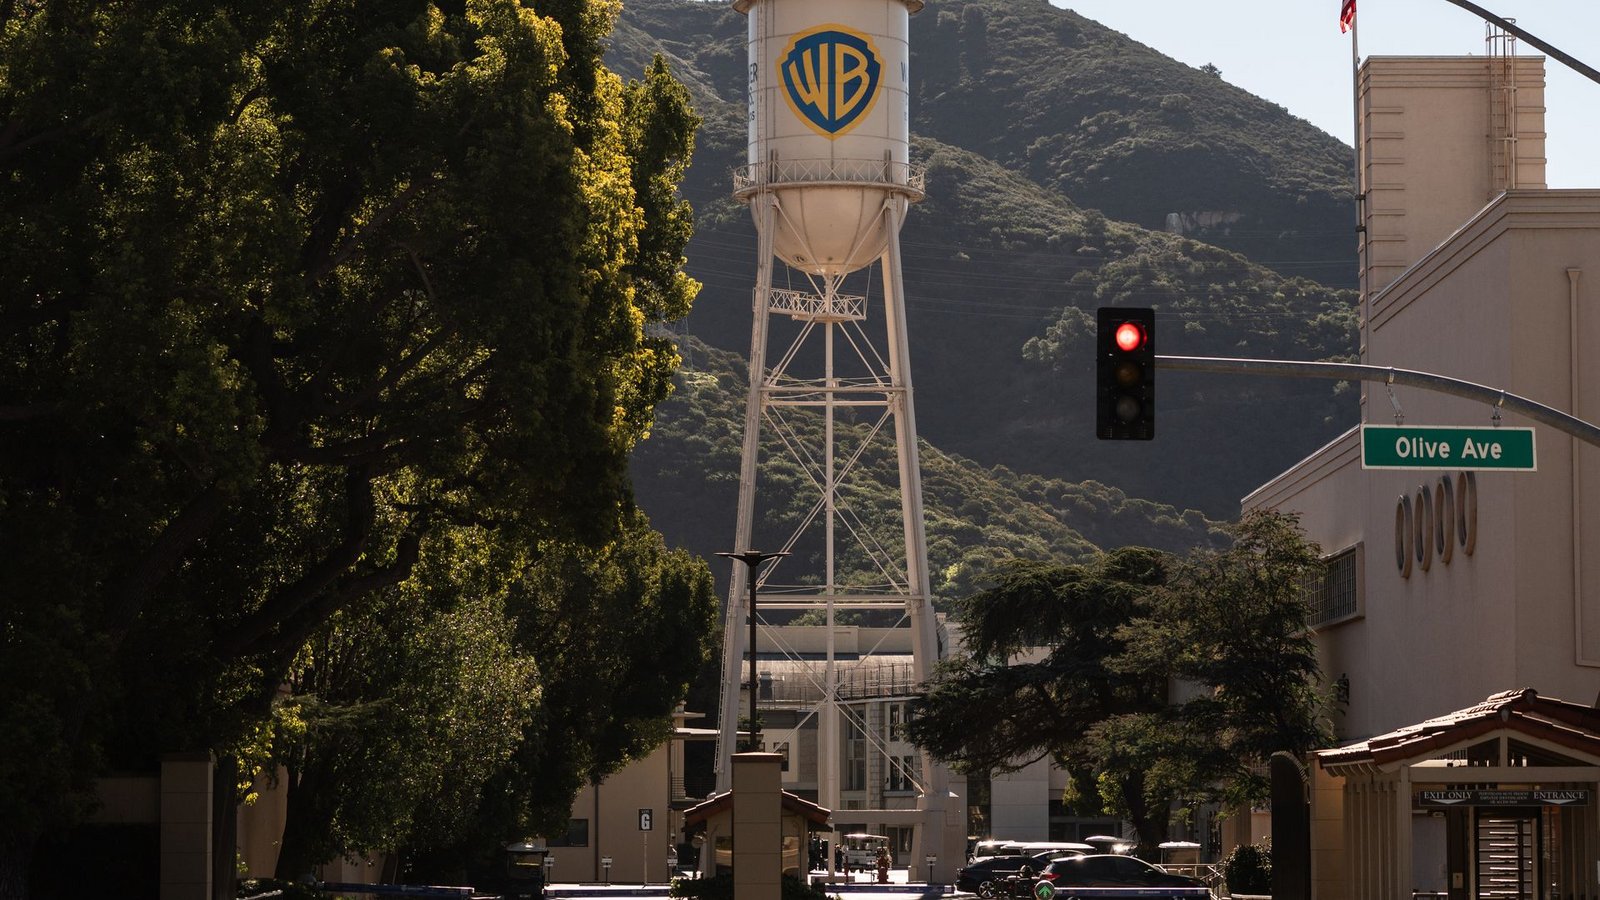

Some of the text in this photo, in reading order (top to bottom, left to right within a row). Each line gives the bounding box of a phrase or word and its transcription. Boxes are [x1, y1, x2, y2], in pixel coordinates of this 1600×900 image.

[788, 42, 870, 121] WB
[1395, 436, 1502, 460] Olive Ave
[1424, 791, 1446, 799] EXIT
[1448, 791, 1473, 799] ONLY
[1533, 791, 1585, 799] ENTRANCE
[641, 813, 650, 830] G
